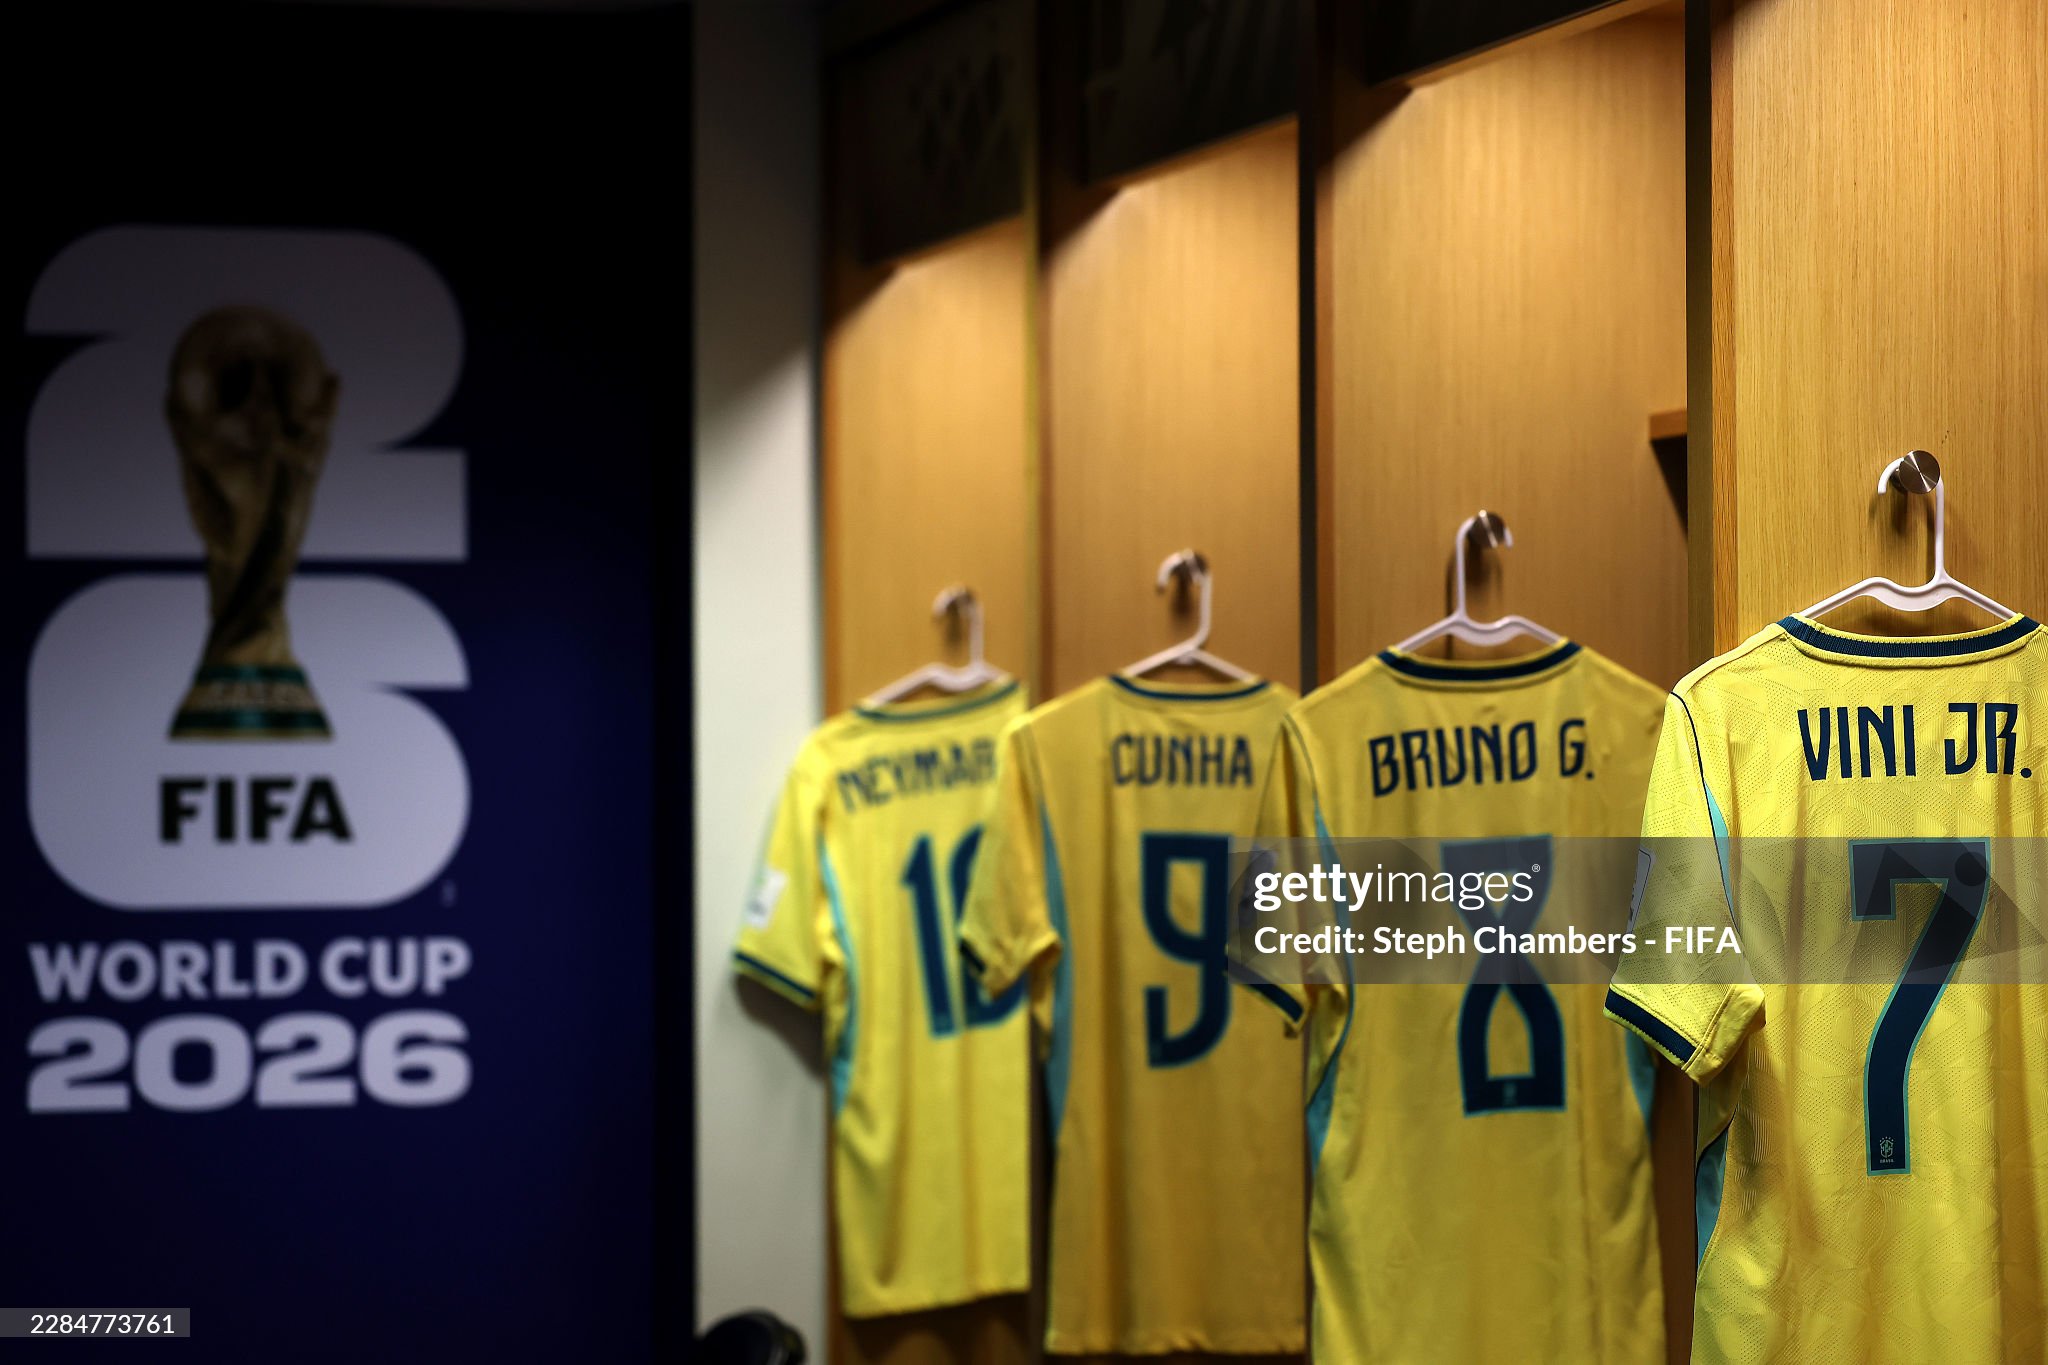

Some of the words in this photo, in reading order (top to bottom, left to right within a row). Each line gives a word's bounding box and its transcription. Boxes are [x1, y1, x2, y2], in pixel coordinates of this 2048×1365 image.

[837, 737, 997, 814] NEYMAR
[1112, 734, 1254, 787] CUNHA
[1369, 722, 1538, 798] BRUNO
[1558, 719, 1595, 780] G.
[1798, 705, 1918, 781] VINI
[1945, 703, 2032, 779] JR.
[158, 775, 353, 845] FIFA
[31, 941, 308, 1000] WORLD
[320, 938, 471, 996] CUP
[1140, 832, 1233, 1069] 9
[1439, 834, 1567, 1119] 8
[1848, 837, 1991, 1175] 7
[27, 1010, 472, 1113] 2026
